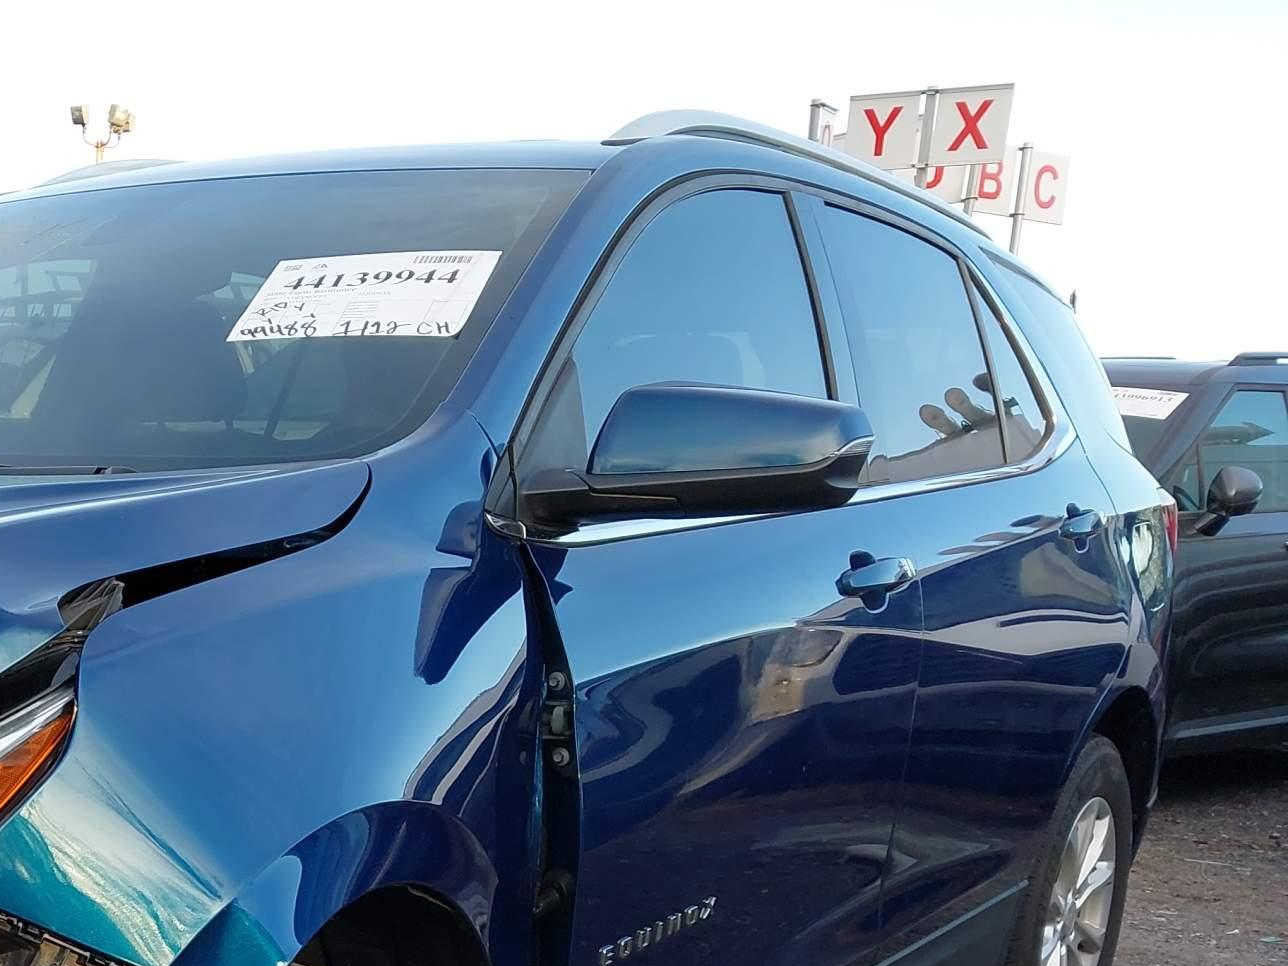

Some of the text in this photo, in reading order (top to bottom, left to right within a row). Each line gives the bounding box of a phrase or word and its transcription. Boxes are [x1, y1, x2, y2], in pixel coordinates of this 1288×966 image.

[863, 105, 904, 157] Y
[947, 100, 994, 152] X
[978, 160, 1004, 200] B
[1033, 164, 1060, 210] C
[284, 269, 459, 290] 44139944
[416, 320, 452, 335] CH
